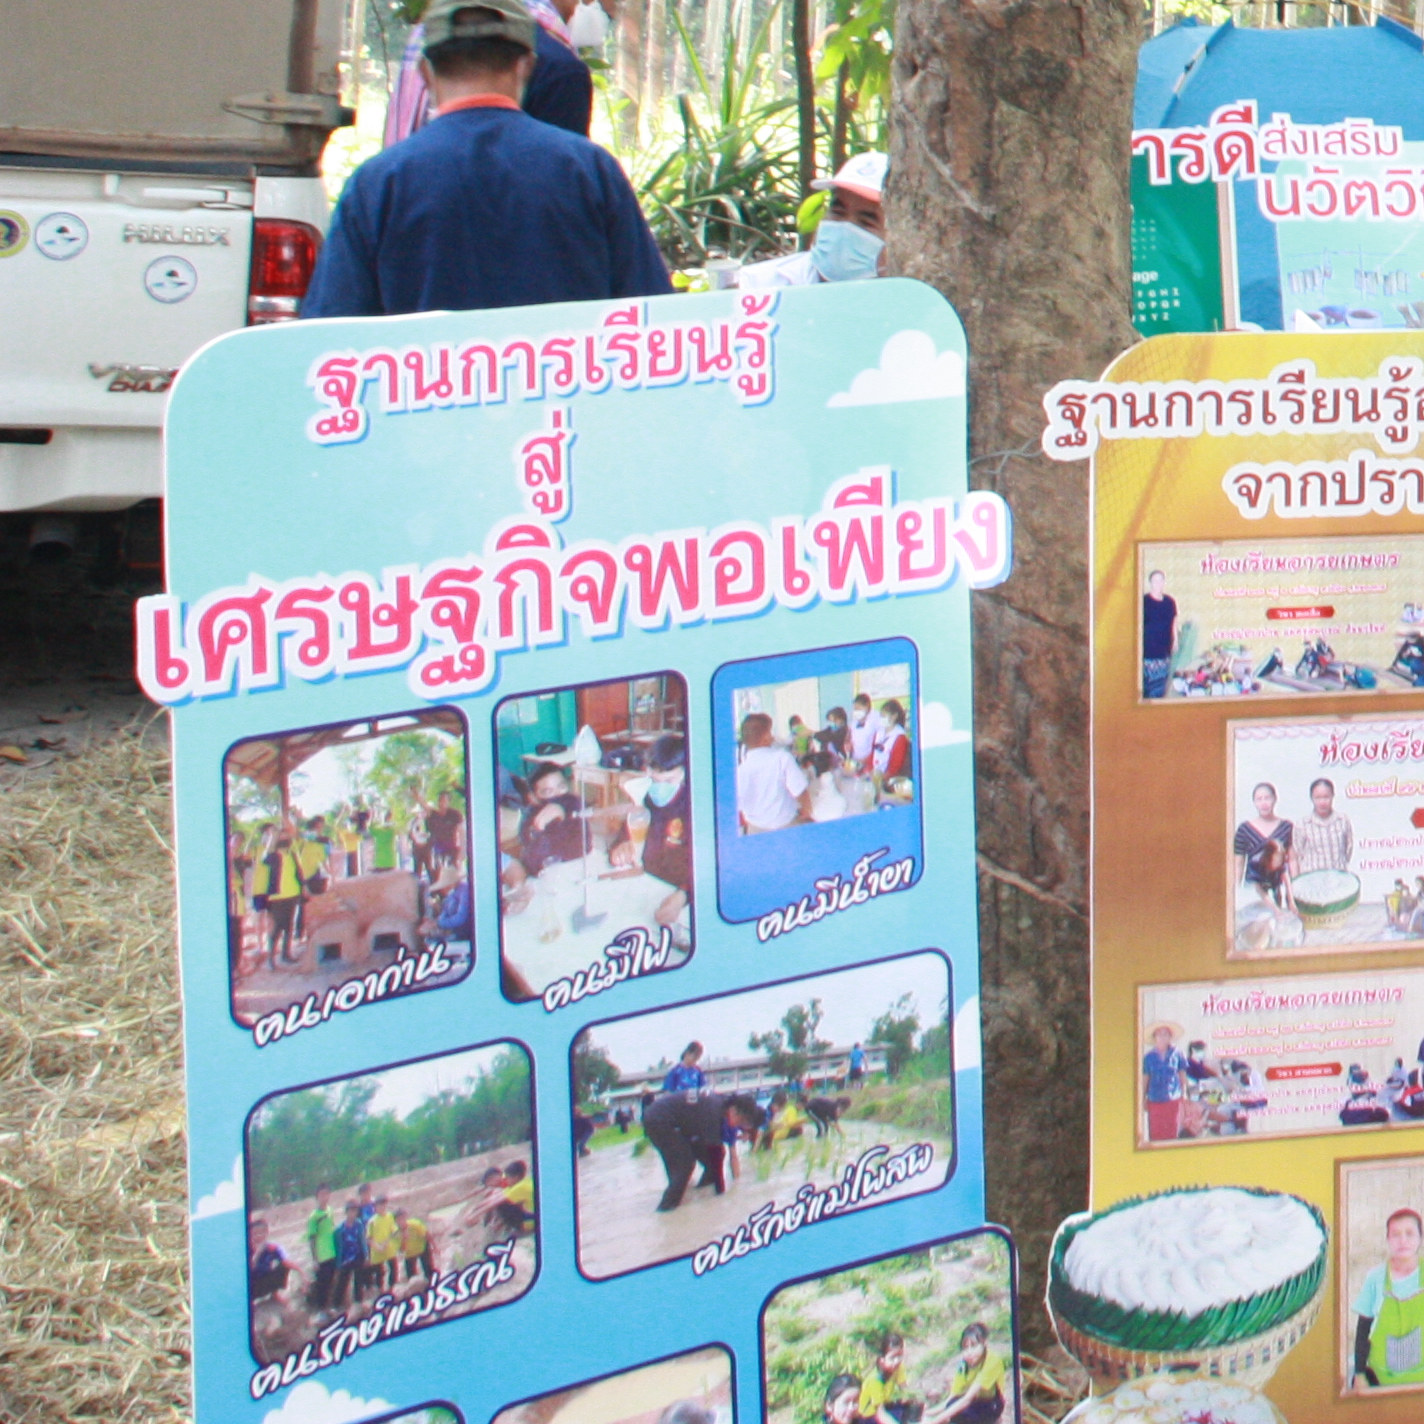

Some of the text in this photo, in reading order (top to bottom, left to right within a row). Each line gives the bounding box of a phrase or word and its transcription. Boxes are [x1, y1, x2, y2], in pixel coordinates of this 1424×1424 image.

[1263, 117, 1399, 156] ส่งเสริม
[123, 224, 230, 245] HILUX
[315, 295, 774, 436] ฐานการเรียนรู้
[522, 412, 567, 514] สู่
[152, 476, 1001, 687] เศรษฐกิจพอเพียง
